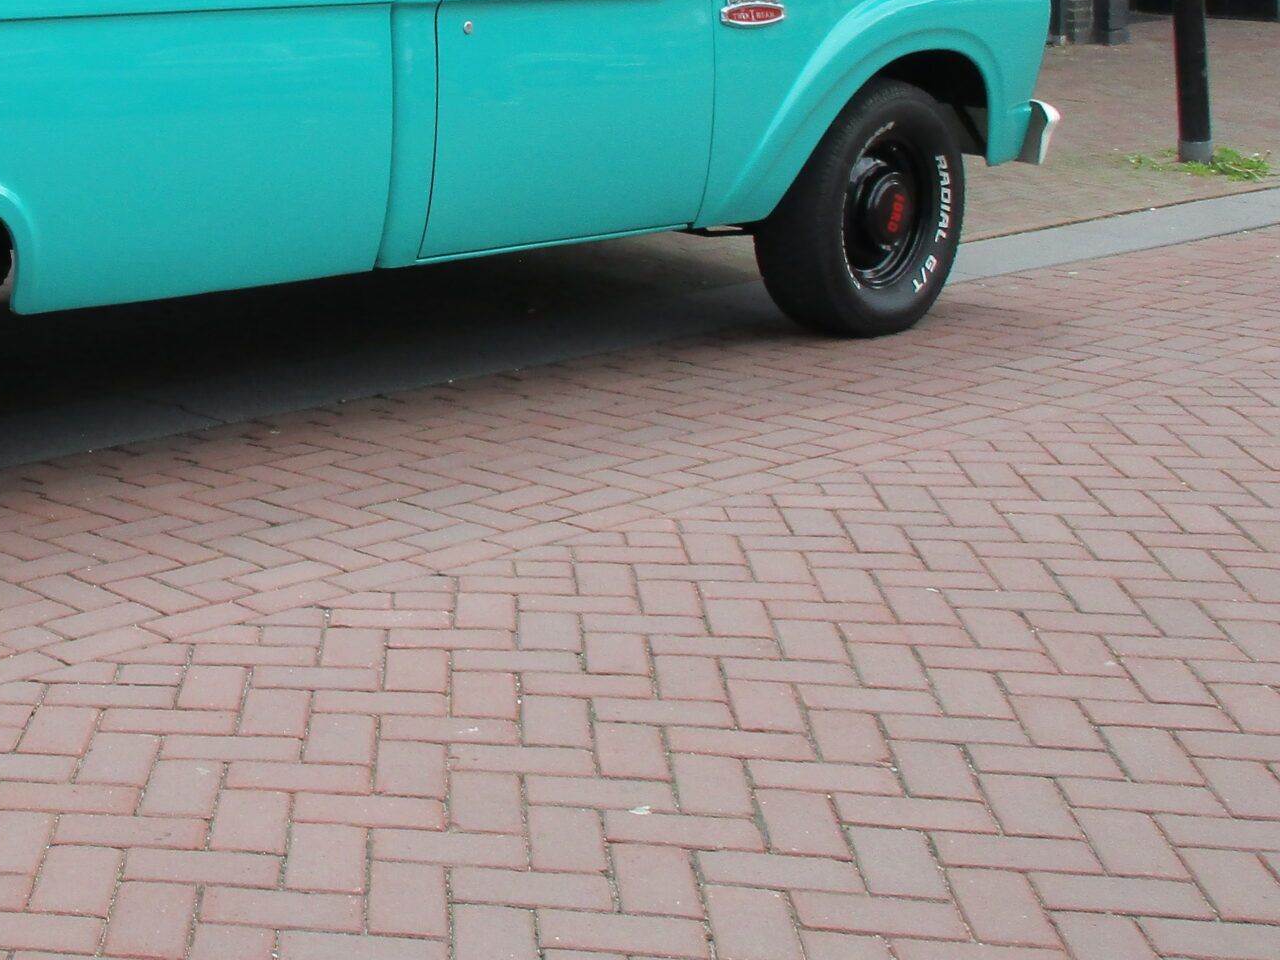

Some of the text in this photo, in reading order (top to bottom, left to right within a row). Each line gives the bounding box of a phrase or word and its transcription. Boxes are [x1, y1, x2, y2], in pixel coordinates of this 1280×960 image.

[887, 193, 905, 233] FORD
[912, 154, 952, 293] RADIAL G/T
